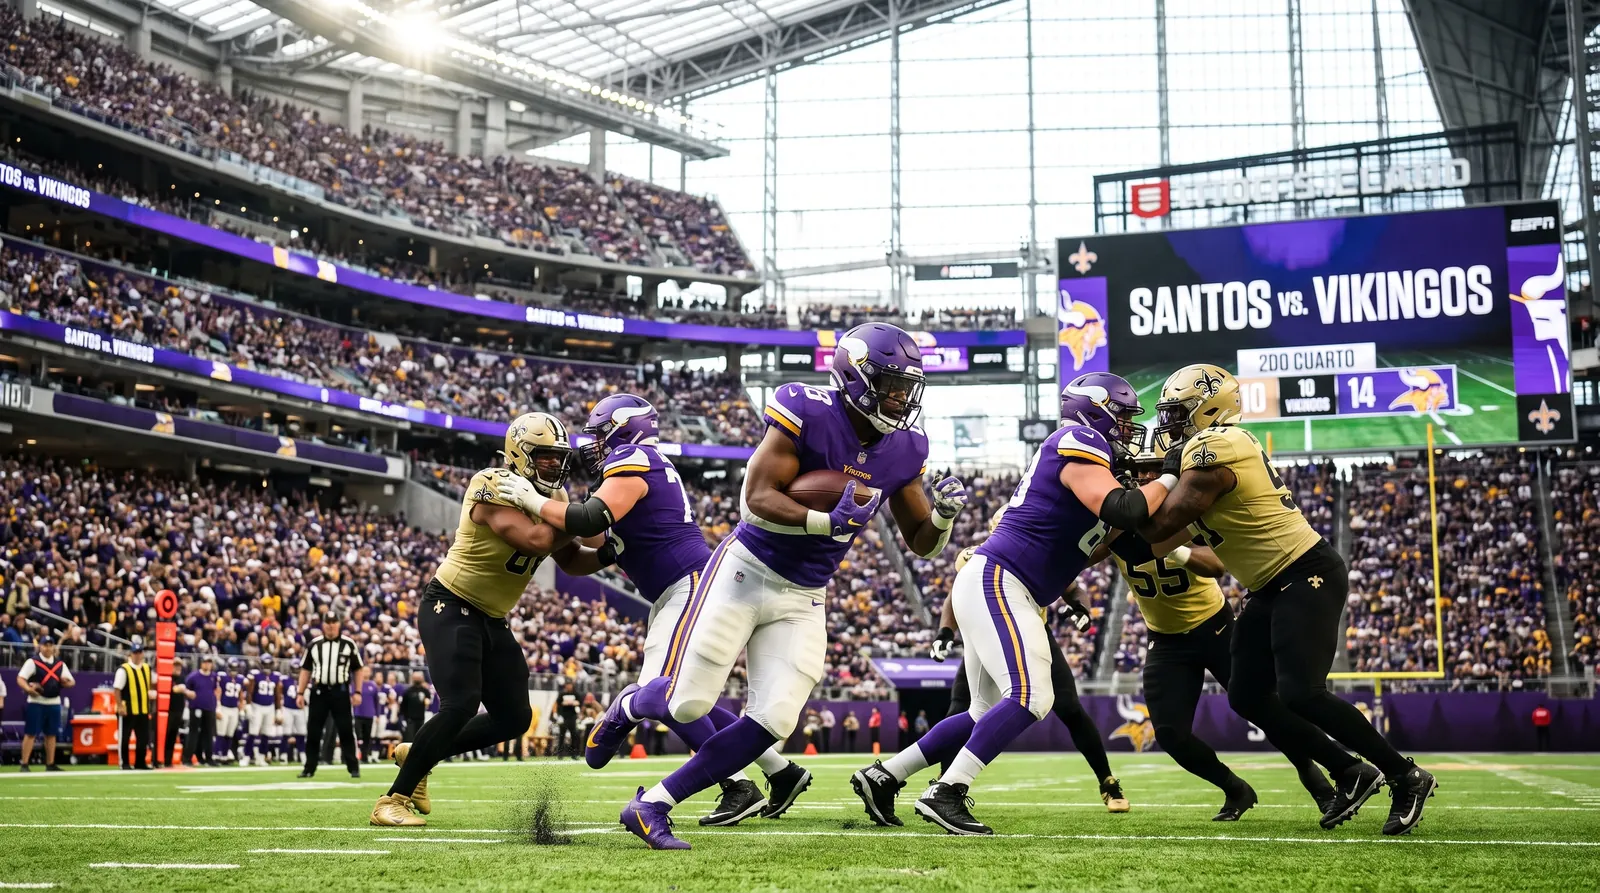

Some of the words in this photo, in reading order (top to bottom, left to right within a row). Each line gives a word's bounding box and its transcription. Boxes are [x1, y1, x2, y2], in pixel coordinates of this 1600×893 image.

[1510, 216, 1555, 232] ESPN
[1129, 279, 1272, 336] SANTOS
[1312, 264, 1493, 325] VIKINGOS
[64, 327, 102, 351] SANTOS
[1259, 353, 1289, 372] 2DO
[1294, 349, 1355, 370] CUARTO
[1241, 382, 1266, 413] 10
[1297, 378, 1316, 397] 10
[1347, 376, 1376, 409] 14
[1125, 556, 1191, 599] 55
[80, 727, 94, 747] G
